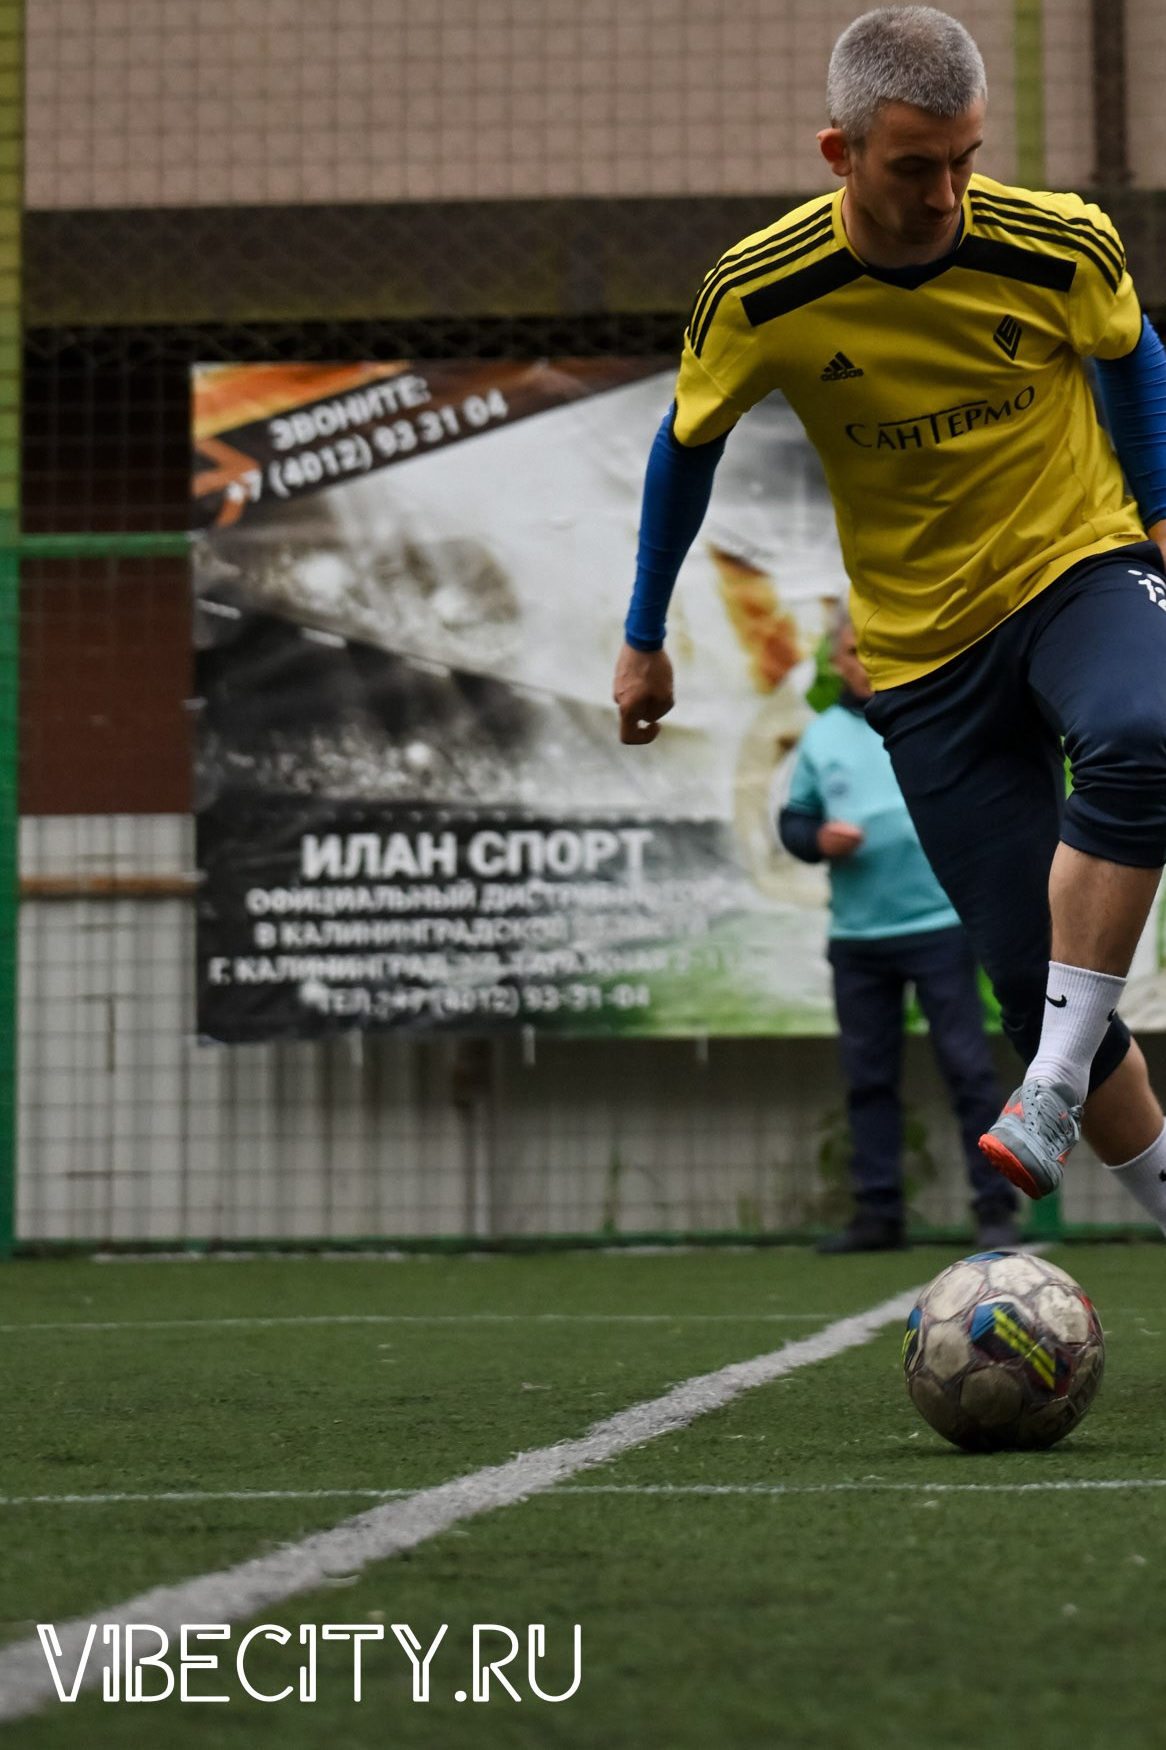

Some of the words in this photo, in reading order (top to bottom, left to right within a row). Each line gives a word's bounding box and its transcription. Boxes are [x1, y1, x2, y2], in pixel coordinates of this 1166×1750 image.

[820, 368, 864, 382] adidas
[268, 374, 432, 451] ЗВОНИТЕ:
[268, 433, 374, 499] (4012)
[302, 831, 458, 879] ИЛАН
[468, 828, 655, 879] СПОРТ
